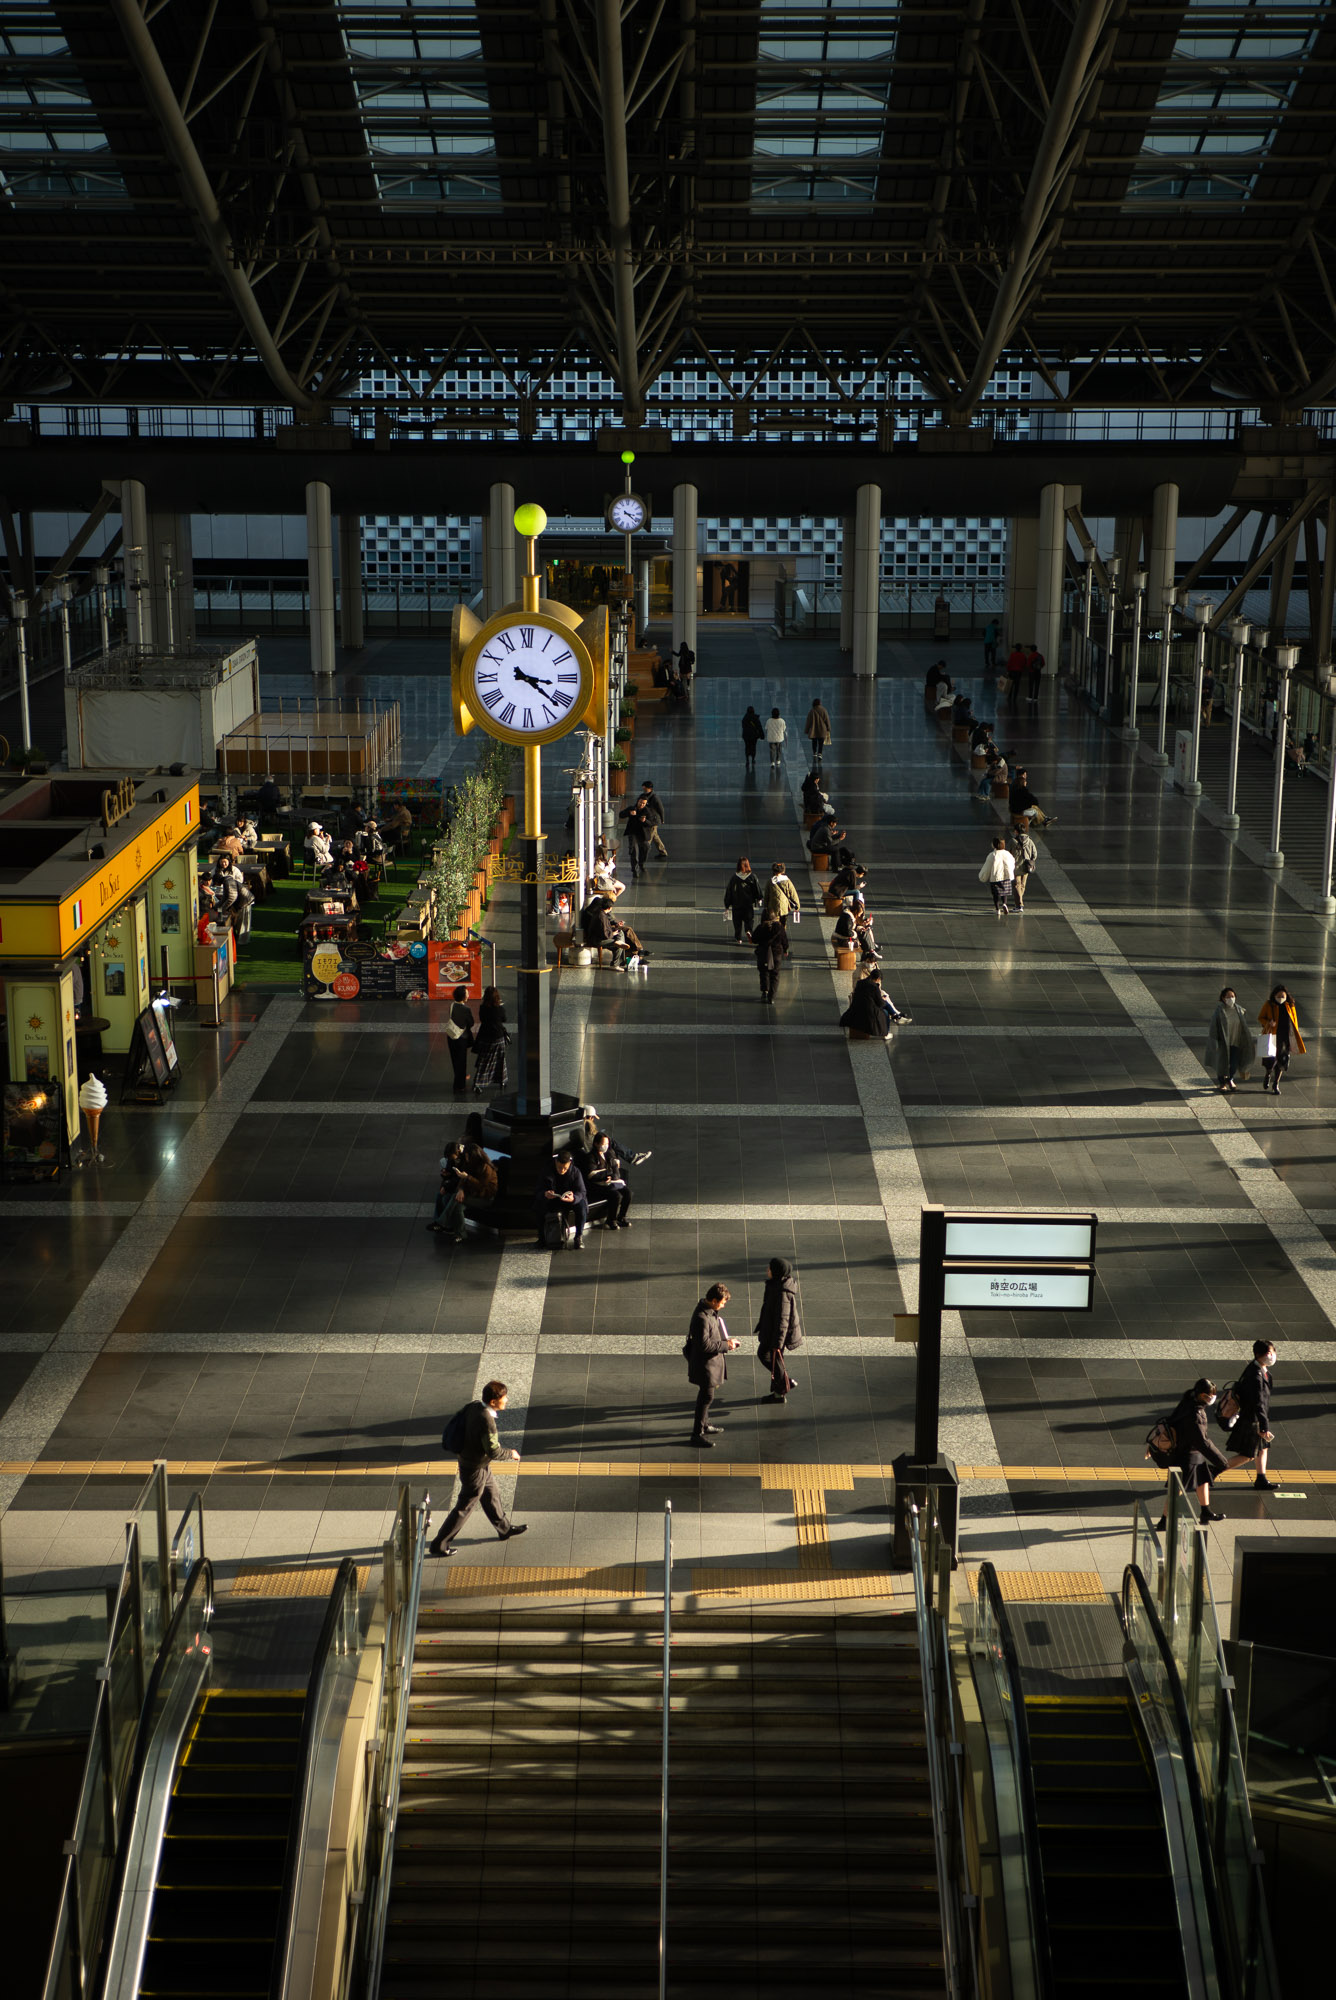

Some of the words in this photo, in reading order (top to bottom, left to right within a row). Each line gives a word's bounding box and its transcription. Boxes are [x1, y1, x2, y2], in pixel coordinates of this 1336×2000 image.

[497, 632, 516, 654] XI
[519, 628, 535, 648] XII
[541, 633, 554, 653] I
[482, 649, 504, 666] X
[552, 650, 573, 666] II
[478, 670, 498, 684] IX
[557, 673, 577, 684] III
[481, 688, 504, 710] VIII
[498, 702, 517, 724] VII
[522, 708, 535, 728] VI
[541, 704, 558, 724] V
[990, 1282, 1038, 1291] 時空の広場
